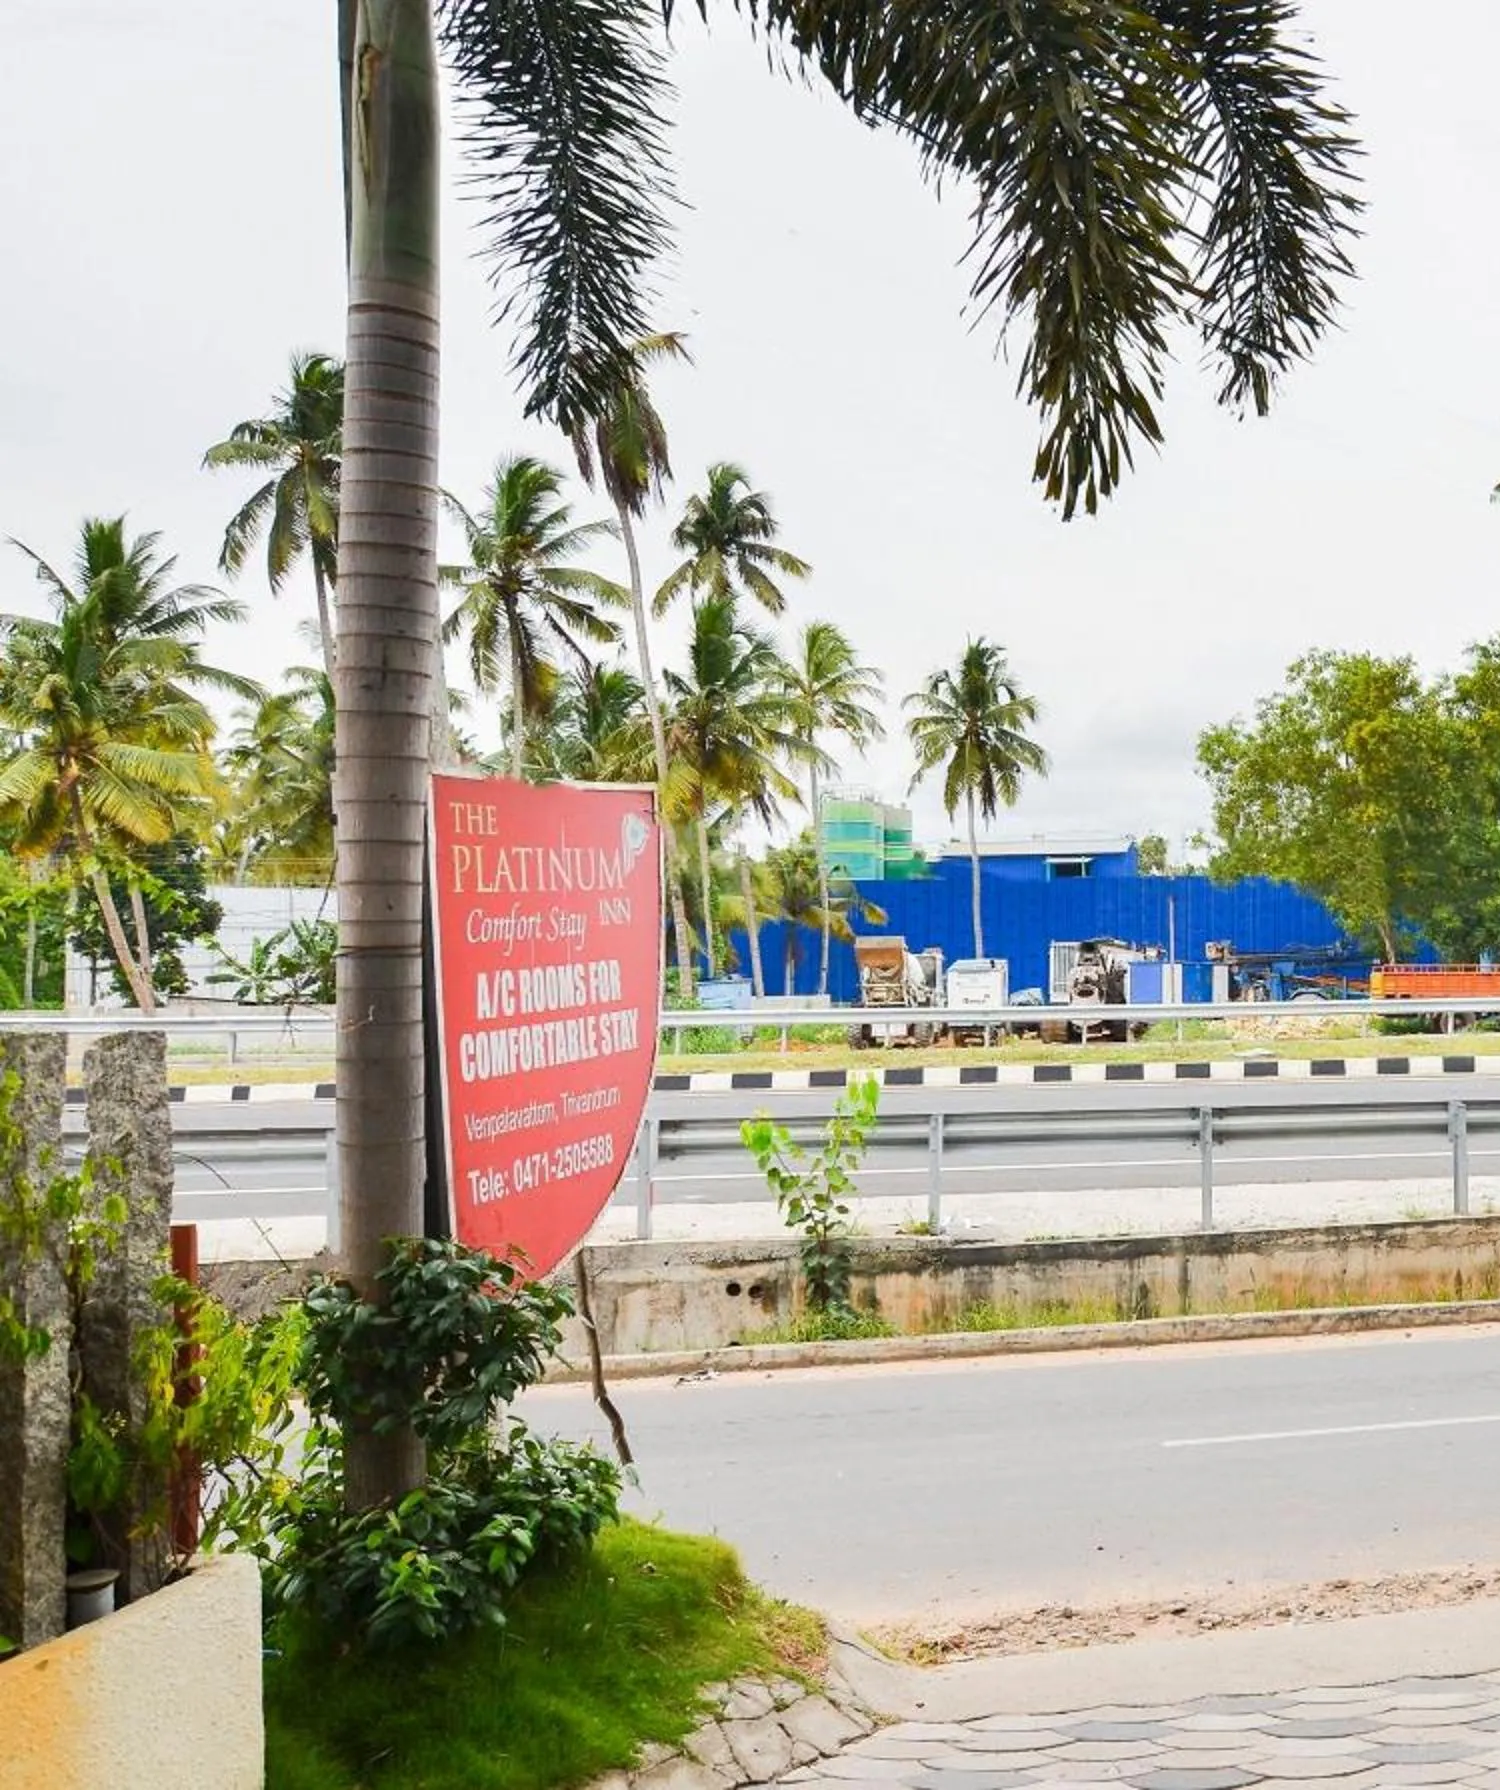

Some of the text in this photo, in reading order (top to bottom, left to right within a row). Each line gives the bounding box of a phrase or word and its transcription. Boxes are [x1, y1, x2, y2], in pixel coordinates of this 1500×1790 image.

[449, 802, 498, 835] THE
[451, 845, 624, 893] PLATINUM
[466, 902, 587, 957] Comfort Stay
[600, 897, 631, 925] INN
[476, 959, 622, 1020] A/C ROOMS FOR
[459, 1008, 640, 1083] COMFORTABLE STAY
[467, 1133, 614, 1205] Tele: 0471-2505588
